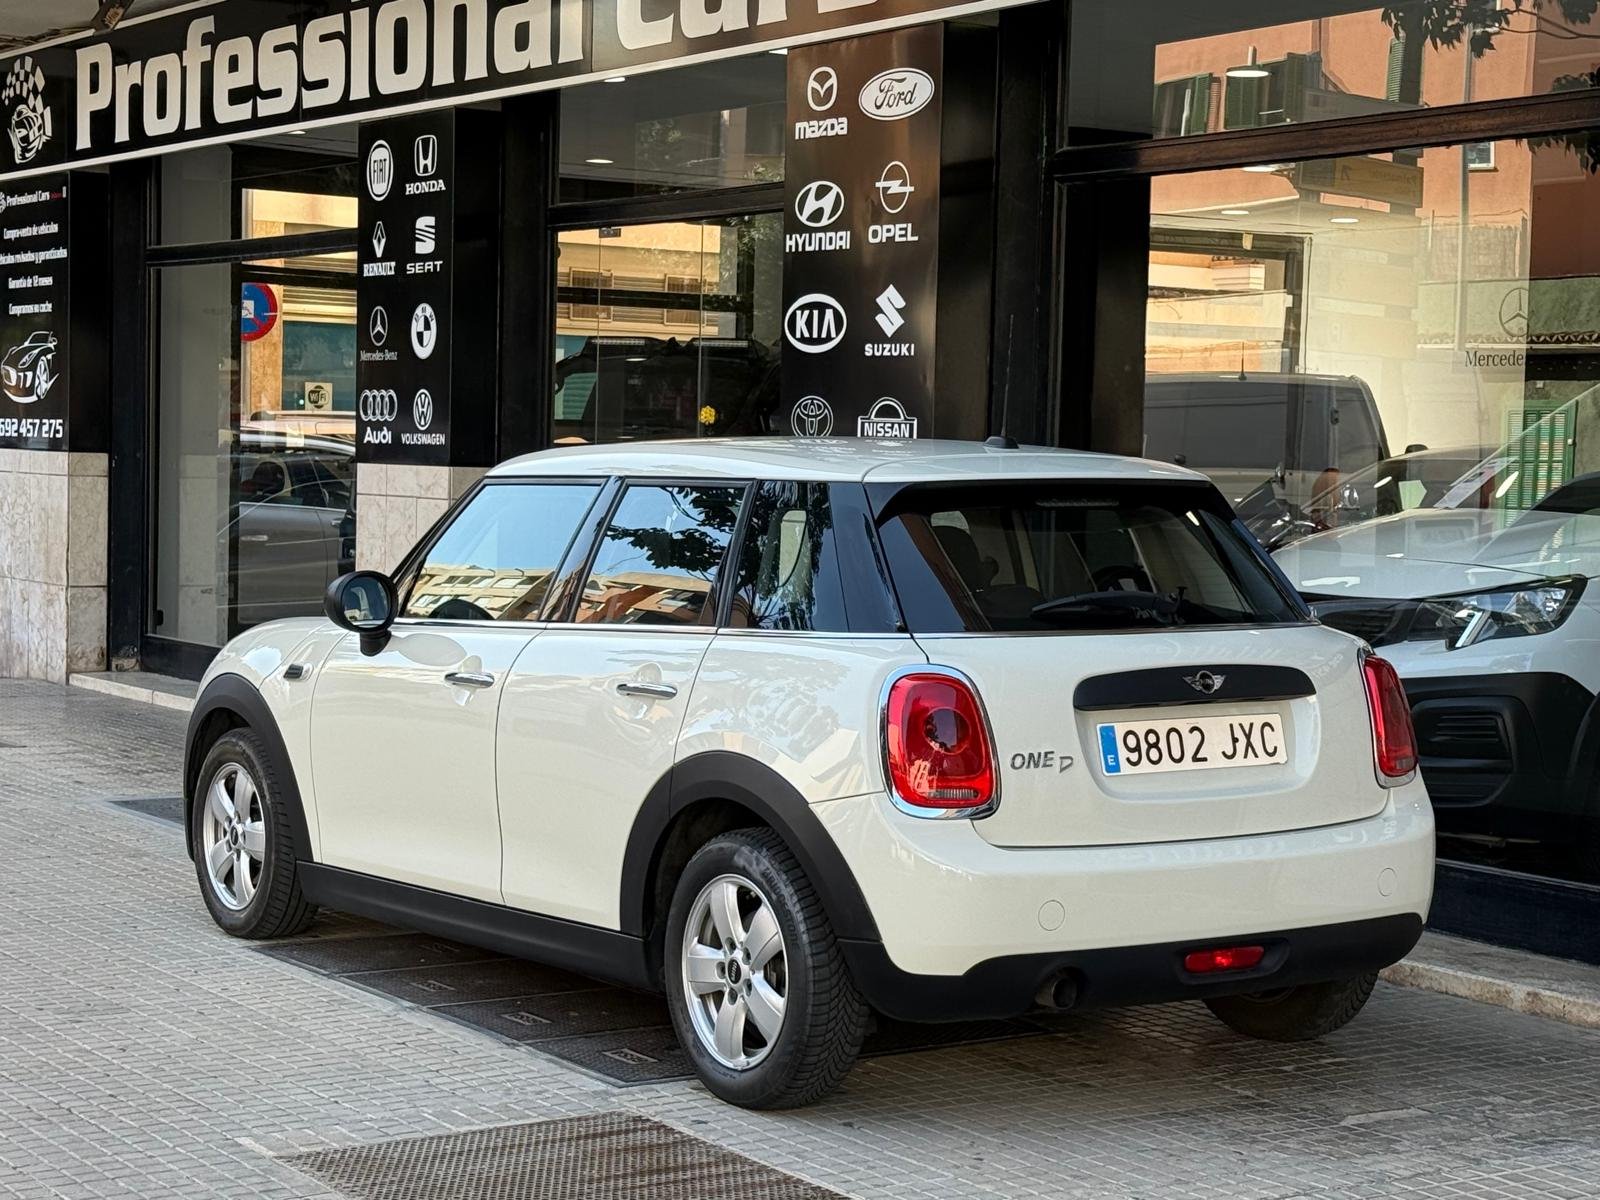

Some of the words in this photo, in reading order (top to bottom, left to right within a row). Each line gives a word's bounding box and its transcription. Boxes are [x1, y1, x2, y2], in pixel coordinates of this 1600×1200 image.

[75, 0, 584, 150] Professional
[874, 77, 918, 110] Ford
[373, 158, 388, 185] FIAT
[405, 179, 446, 196] HONDA
[7, 191, 38, 206] Professional
[785, 231, 851, 253] HYUNDAI
[868, 223, 919, 243] OPEL
[363, 261, 396, 277] RENAULT
[406, 260, 444, 275] SEAT
[414, 306, 435, 323] BMW
[795, 308, 837, 339] KIA
[360, 349, 398, 362] Mercedes-Benz
[864, 343, 915, 357] SUZUKI
[1465, 350, 1525, 368] Mercede
[0, 418, 19, 437] 692
[19, 418, 40, 437] 457
[41, 418, 64, 438] 275
[363, 426, 392, 444] Audi
[864, 422, 910, 438] NISSAN
[401, 433, 446, 445] VOLKSWAGEN
[1107, 754, 1116, 766] E
[1123, 725, 1208, 767] 9802
[1221, 721, 1279, 760] JXC
[1010, 751, 1055, 771] ONE
[1059, 755, 1074, 773] D
